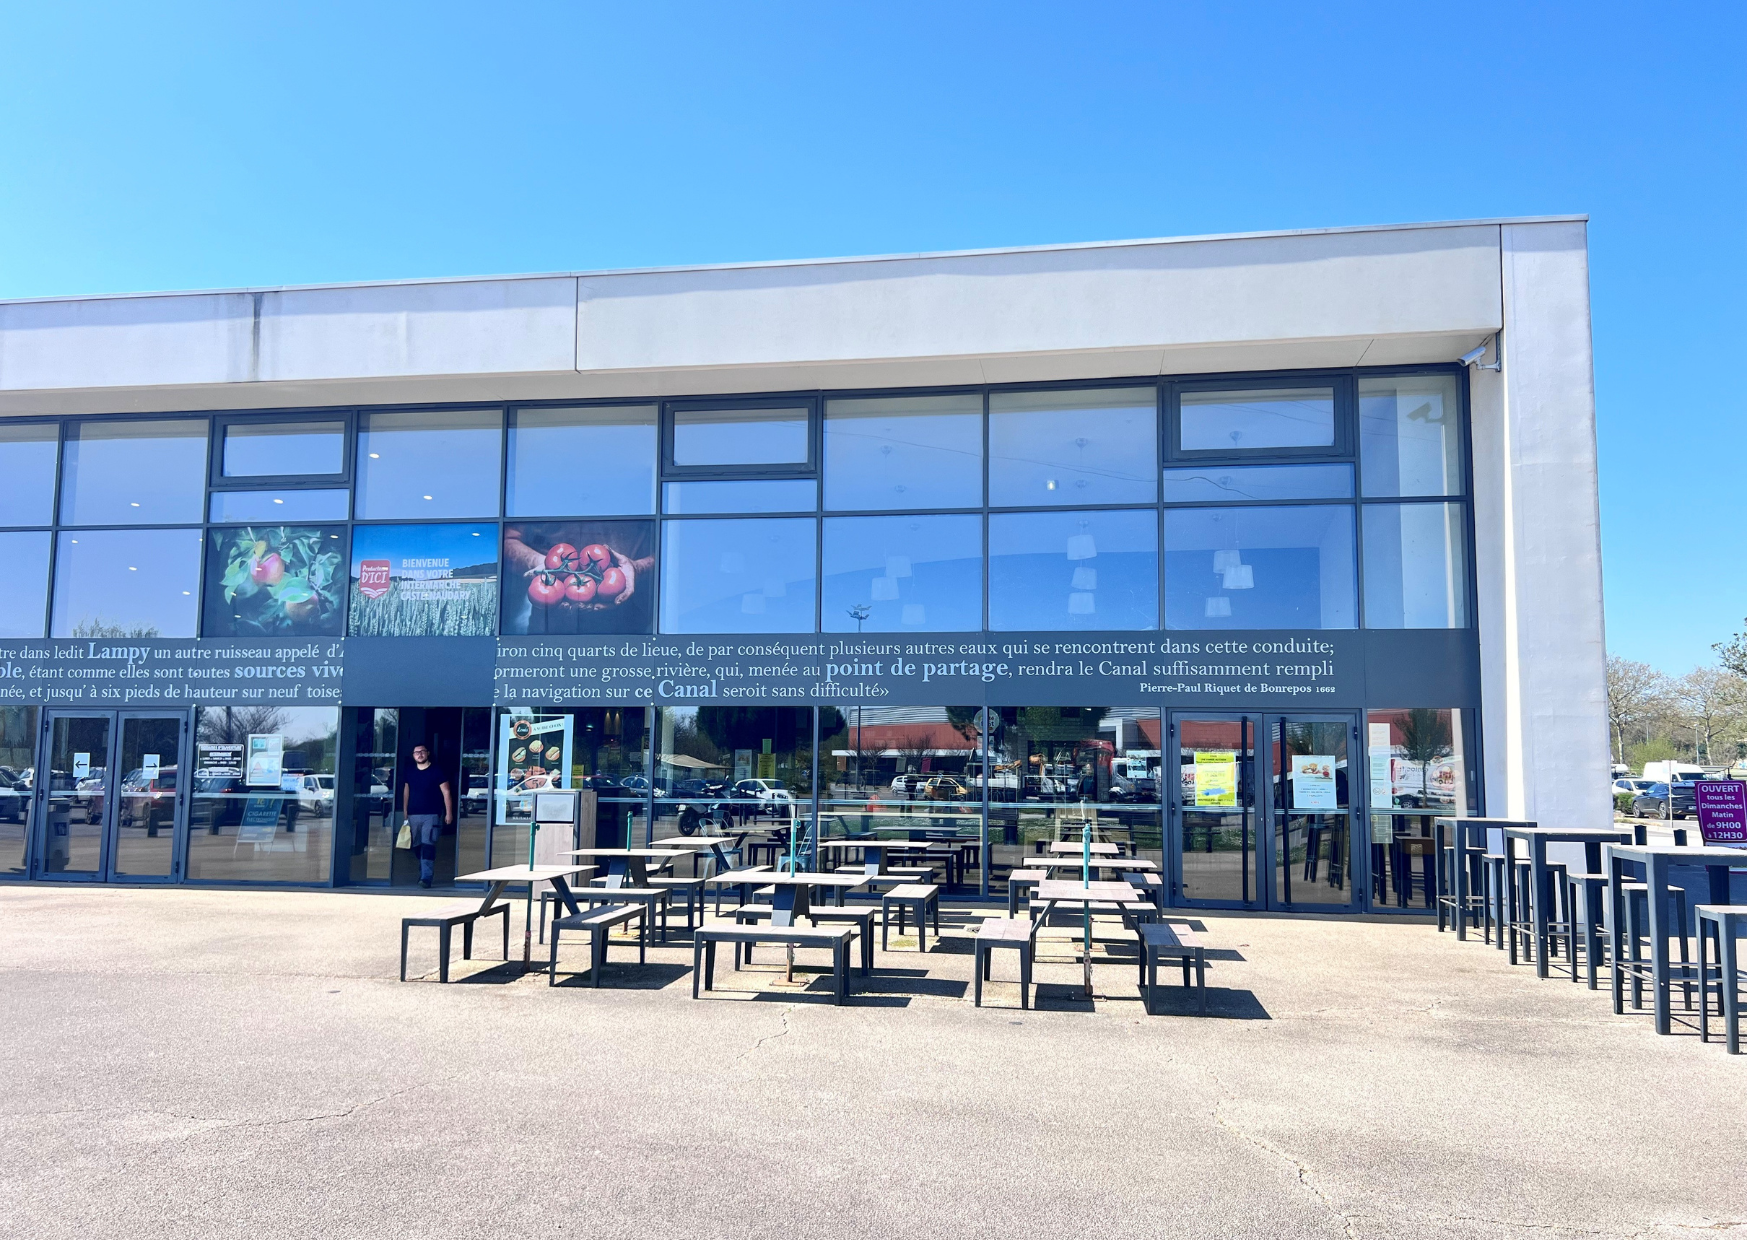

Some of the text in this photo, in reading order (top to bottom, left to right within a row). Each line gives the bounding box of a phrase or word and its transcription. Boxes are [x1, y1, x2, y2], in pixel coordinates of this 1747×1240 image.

[402, 558, 449, 567] BIENVENUE
[401, 569, 454, 579] DANS VOTRE
[400, 580, 461, 590] INTERMARCHE
[20, 646, 50, 658] dans
[54, 645, 84, 659] ledit
[87, 643, 150, 665] Lampy
[154, 649, 171, 658] un
[175, 647, 211, 658] autre
[215, 645, 271, 658] ruisseau
[275, 644, 319, 662] appelé
[532, 643, 563, 661] cinq
[568, 645, 615, 661] quarts
[620, 642, 638, 656] de
[642, 642, 681, 658] lieue,
[686, 642, 704, 656] de
[708, 646, 733, 660] par
[738, 642, 825, 659] conséquent
[829, 642, 901, 660] plusieurs
[906, 642, 954, 654] autres
[960, 645, 998, 654] eaux
[1003, 640, 1028, 658] qui
[1034, 644, 1050, 654] se
[1055, 641, 1155, 654] rencontrent
[1161, 638, 1200, 653] dans
[1206, 641, 1248, 653] cette
[1253, 638, 1333, 656] conduite;
[29, 665, 64, 678] étant
[68, 669, 115, 678] comme
[119, 664, 149, 678] elles
[154, 667, 183, 678] sont
[188, 667, 230, 678] toutes
[234, 666, 305, 678] sources
[570, 668, 596, 677] une
[601, 668, 651, 682] grosse
[656, 663, 711, 679] rivière,
[715, 662, 743, 680] qui,
[749, 662, 798, 676] menée
[803, 667, 820, 676] au
[826, 657, 883, 682] point
[891, 658, 916, 675] de
[922, 657, 1013, 682] partage,
[1018, 661, 1073, 675] rendra
[1079, 661, 1093, 675] le
[1099, 661, 1147, 675] Canal
[1154, 661, 1270, 675] suffisamment
[1276, 660, 1334, 680] rempli
[30, 687, 42, 697] et
[102, 684, 121, 697] six
[125, 684, 160, 702] pieds
[164, 684, 180, 698] de
[184, 684, 238, 698] hauteur
[242, 689, 264, 698] sur
[268, 684, 301, 698] neuf
[504, 684, 517, 699] la
[522, 684, 600, 703] navigation
[606, 688, 630, 698] sur
[635, 688, 652, 698] ce
[658, 677, 718, 697] Canal
[723, 683, 767, 697] seroit
[772, 687, 805, 697] sans
[810, 680, 889, 697] difficulté»
[1140, 683, 1201, 692] Pierre-Paul
[1204, 683, 1241, 695] Riquet
[1244, 683, 1257, 692] de
[1260, 683, 1312, 695] Bonrepos
